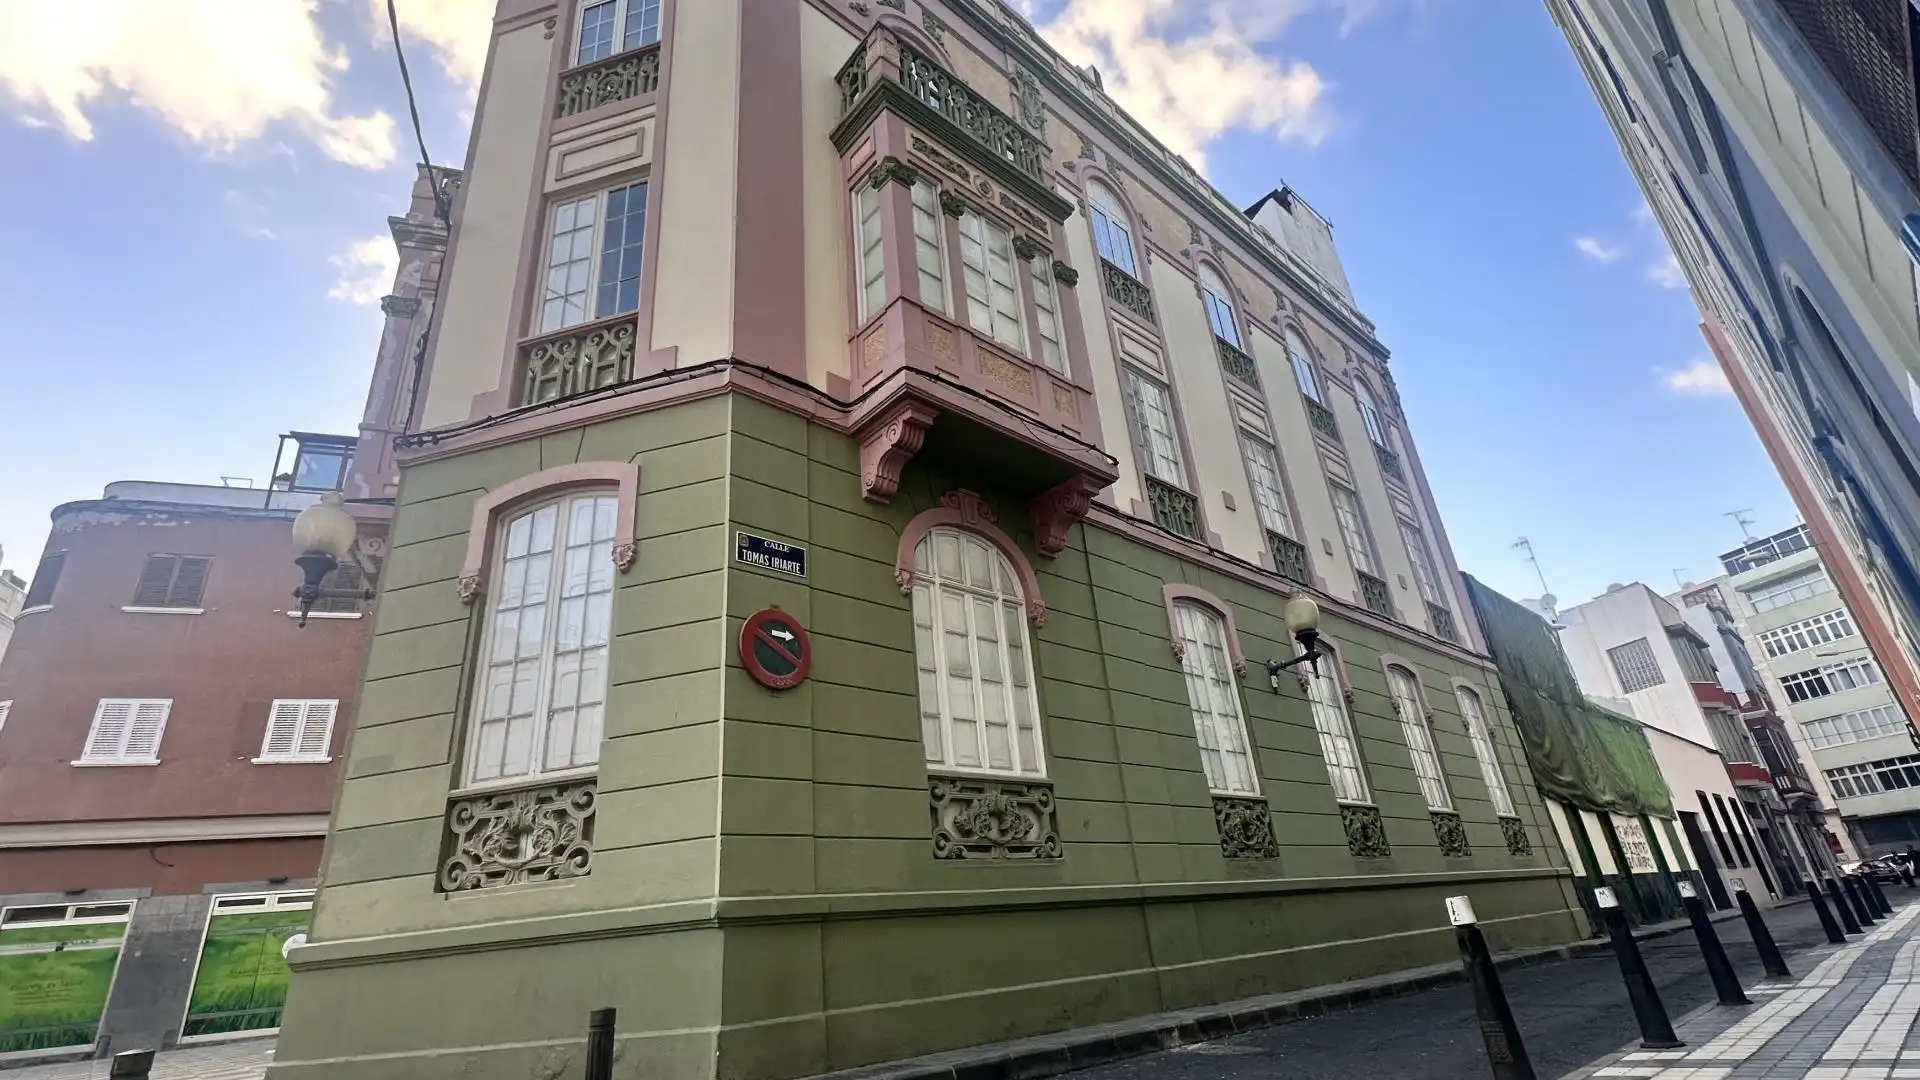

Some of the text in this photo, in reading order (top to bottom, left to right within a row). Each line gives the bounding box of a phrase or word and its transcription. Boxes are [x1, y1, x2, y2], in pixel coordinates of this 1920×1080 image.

[764, 540, 790, 553] CALLE
[742, 549, 801, 574] TOMAS IRIARTE
